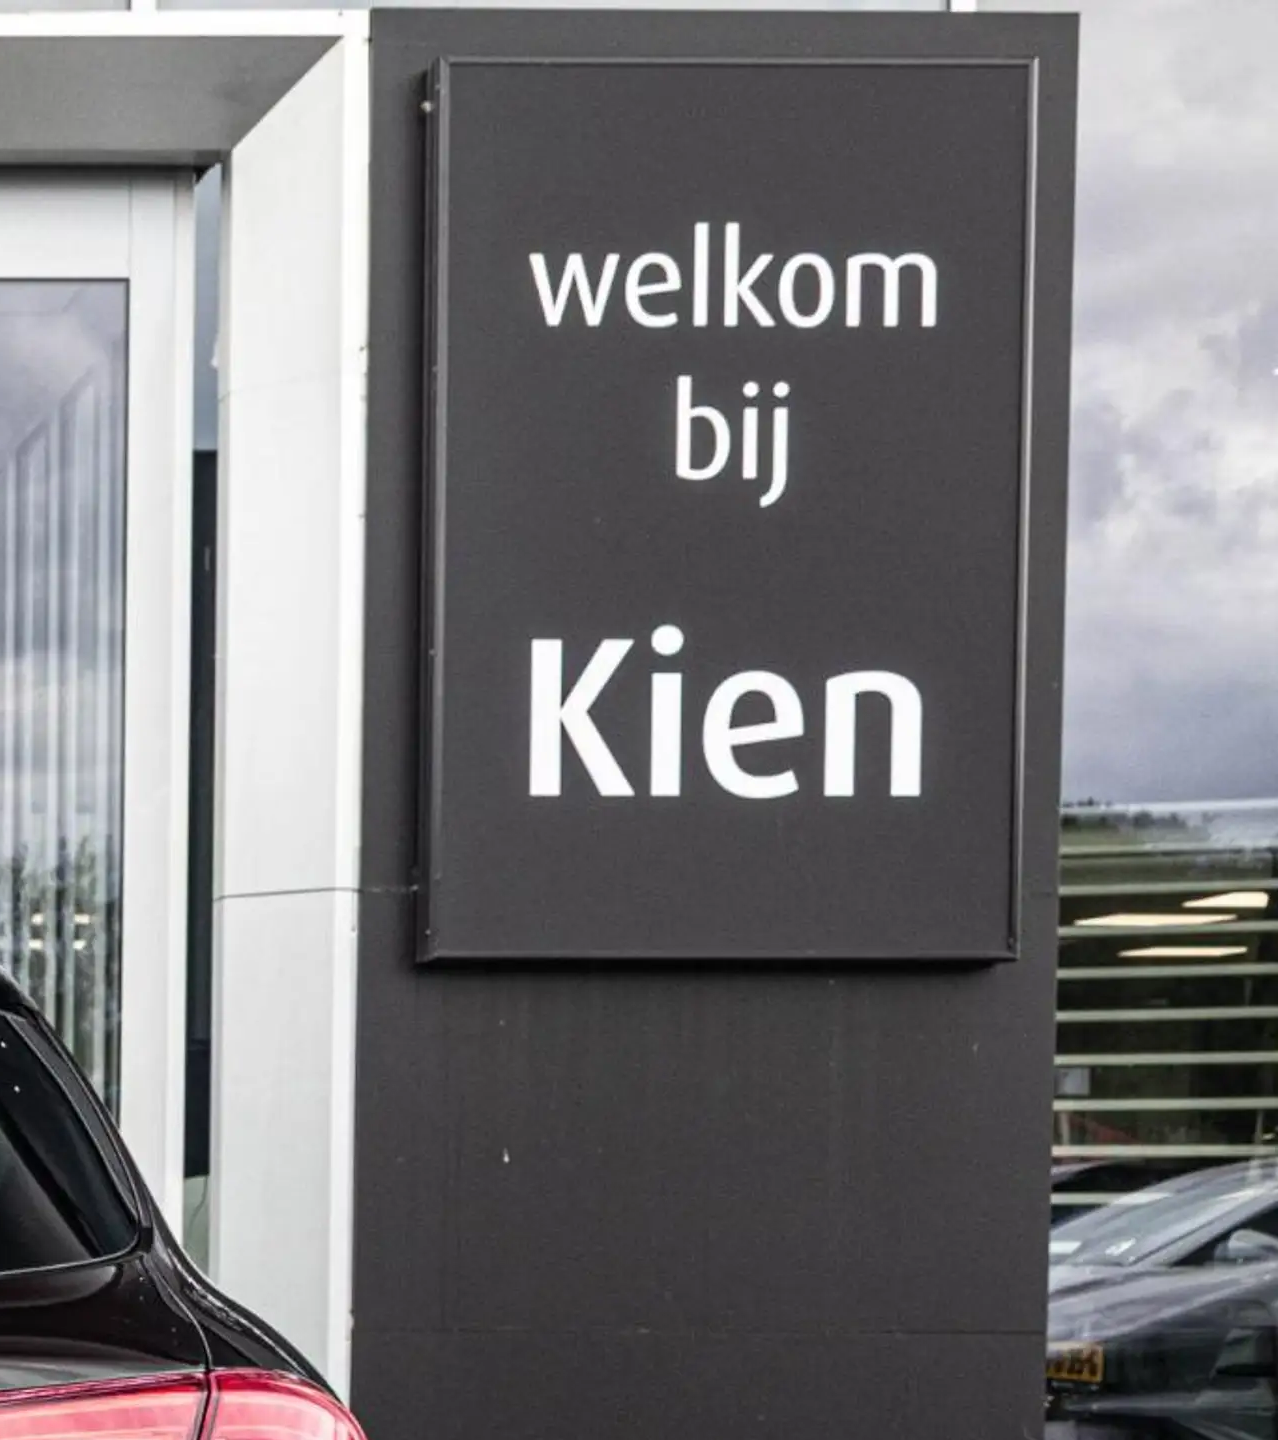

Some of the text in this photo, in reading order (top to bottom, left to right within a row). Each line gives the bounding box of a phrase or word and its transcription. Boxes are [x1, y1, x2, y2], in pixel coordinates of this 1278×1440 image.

[529, 222, 938, 328] welkom
[676, 375, 790, 508] bij
[529, 624, 923, 799] Kien
